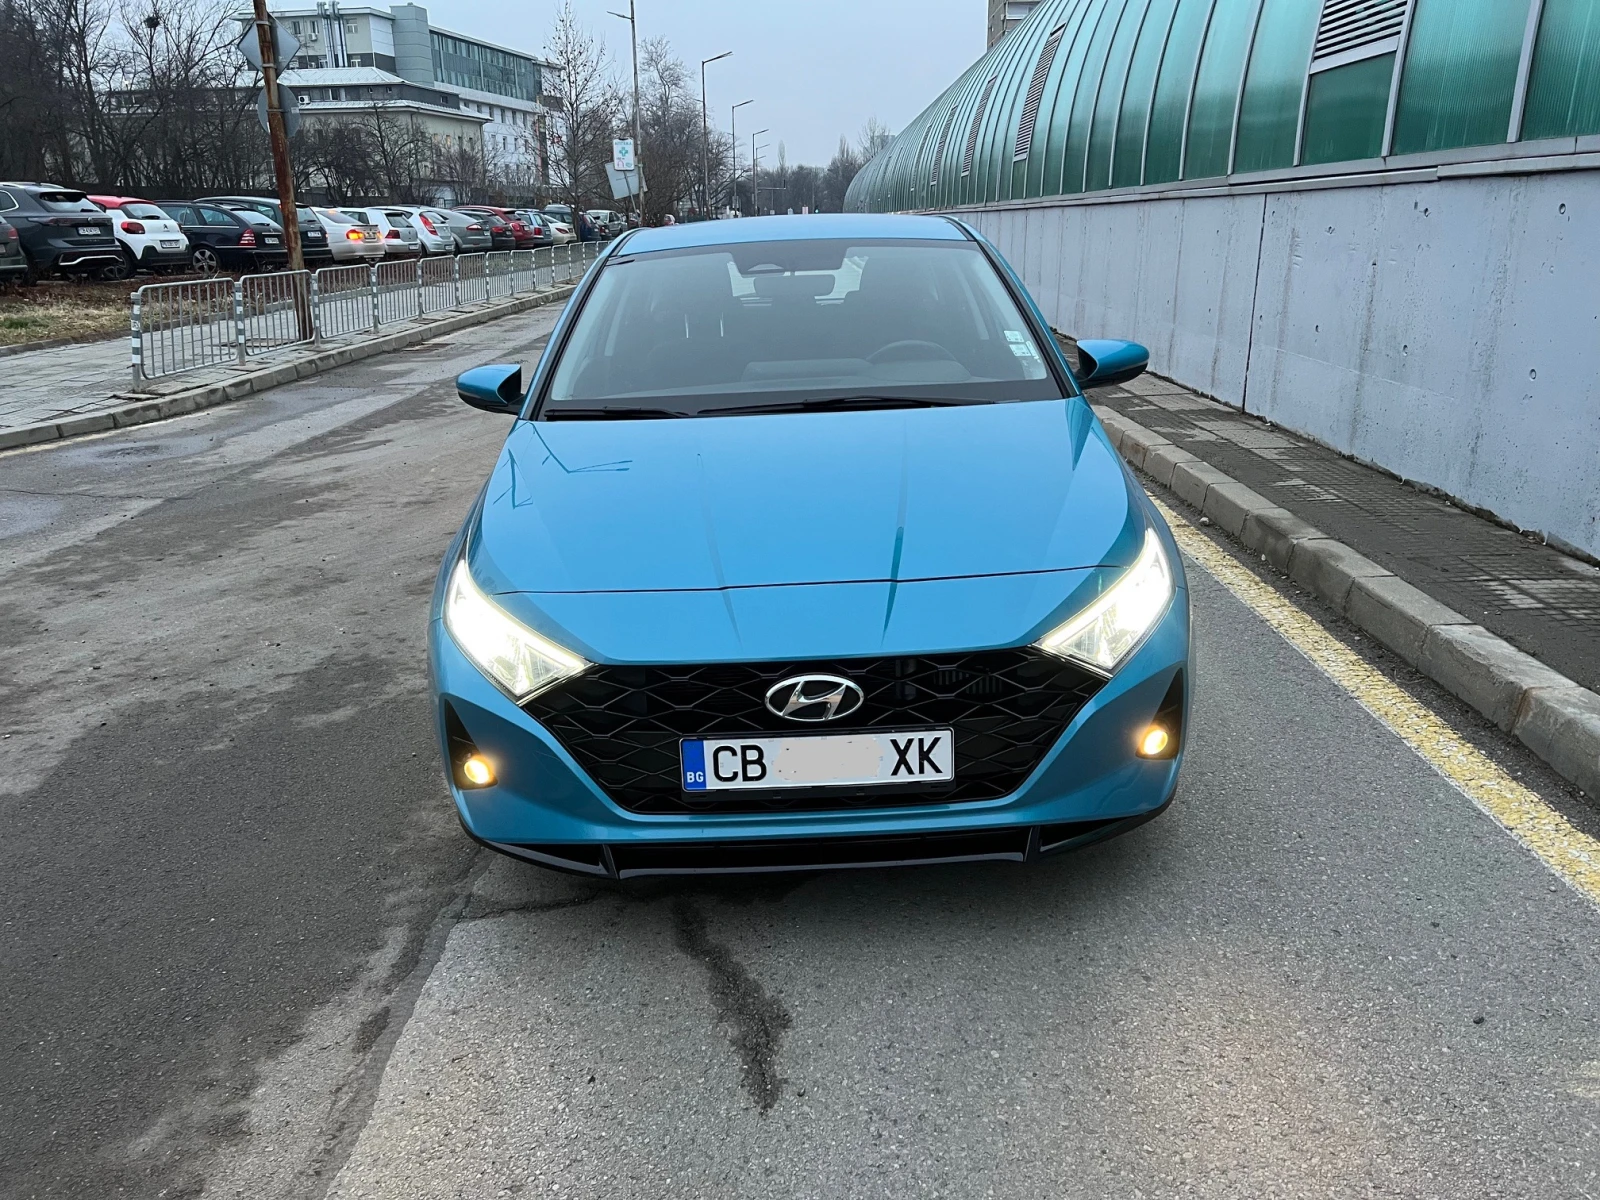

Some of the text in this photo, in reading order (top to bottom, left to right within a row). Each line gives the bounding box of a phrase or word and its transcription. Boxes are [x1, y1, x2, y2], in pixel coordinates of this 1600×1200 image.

[712, 736, 943, 783] CB XK
[686, 771, 704, 783] BG
